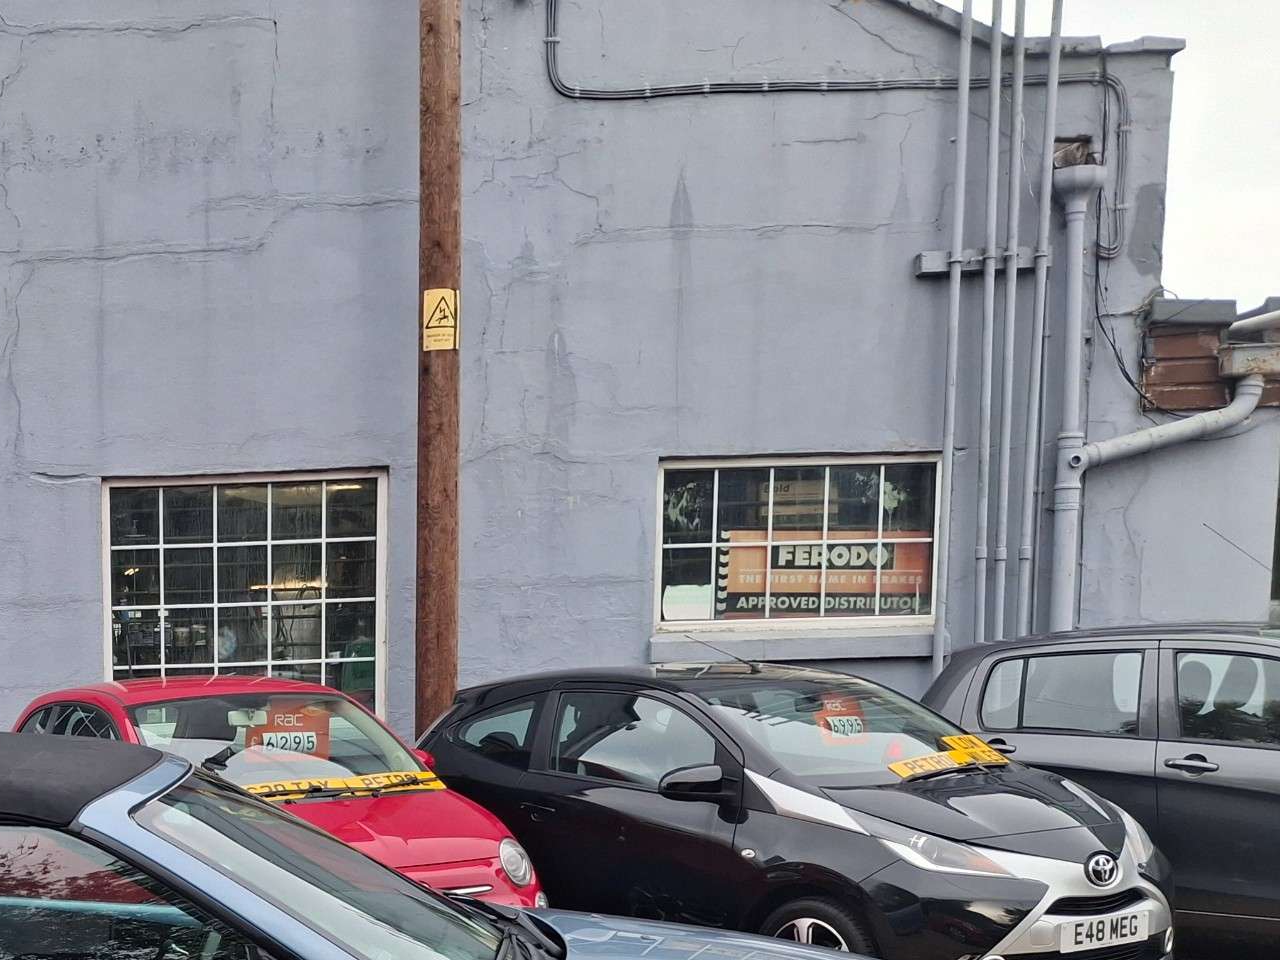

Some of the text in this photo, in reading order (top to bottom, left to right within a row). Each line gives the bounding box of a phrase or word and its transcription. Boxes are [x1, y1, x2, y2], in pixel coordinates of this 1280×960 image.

[778, 545, 889, 567] FERODO
[738, 575, 762, 584] THE
[852, 575, 866, 584] IN
[736, 596, 819, 609] APPROVED
[1074, 914, 1138, 945] E48 MEG
